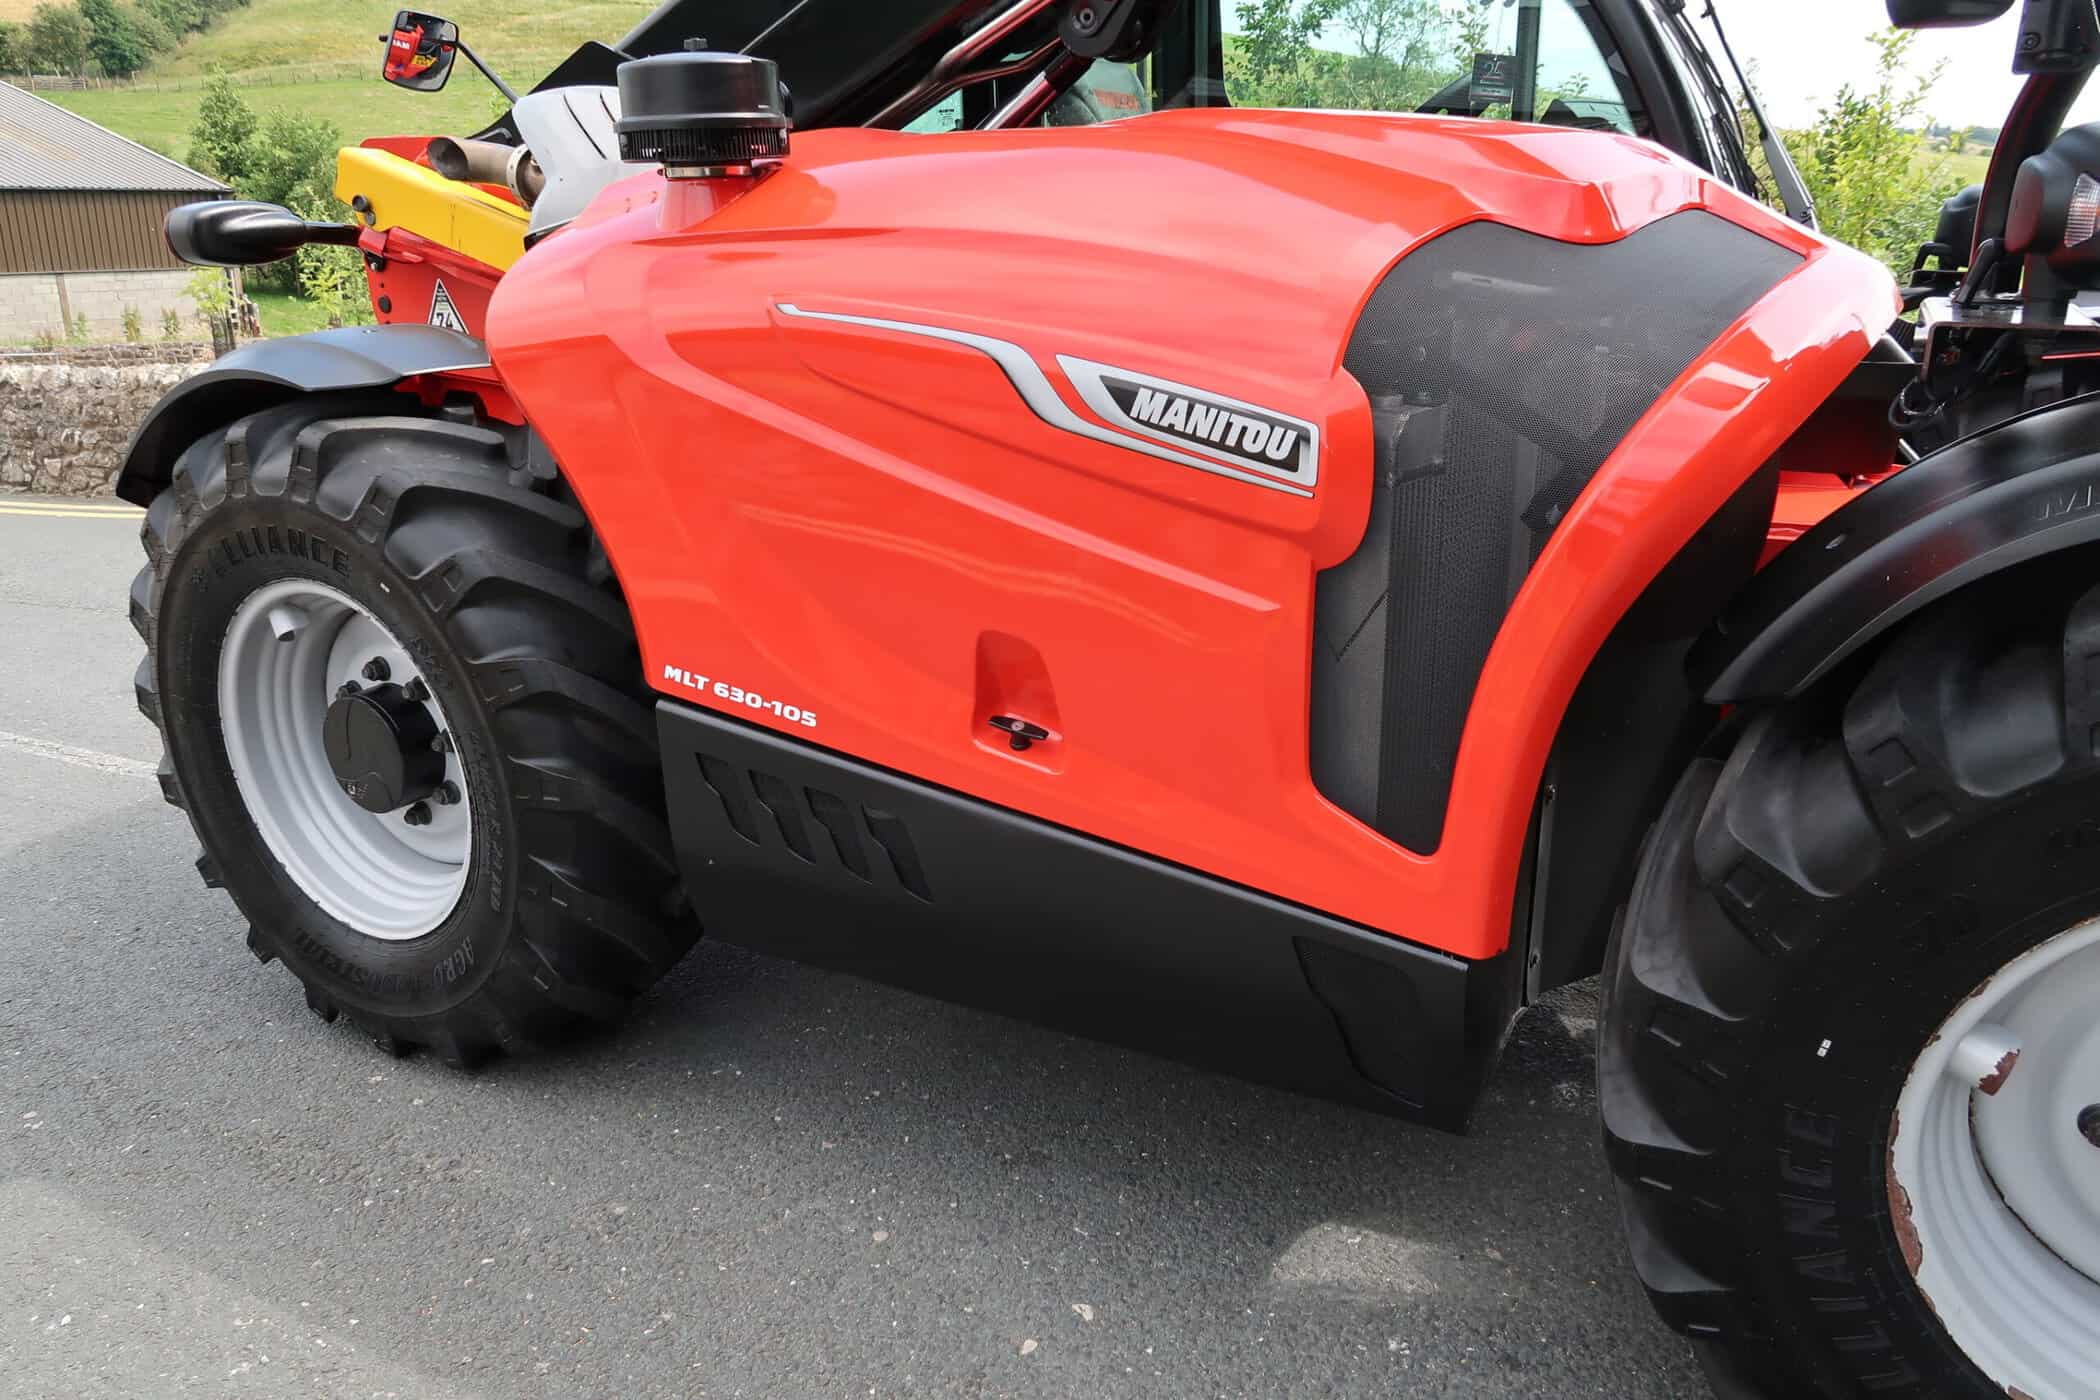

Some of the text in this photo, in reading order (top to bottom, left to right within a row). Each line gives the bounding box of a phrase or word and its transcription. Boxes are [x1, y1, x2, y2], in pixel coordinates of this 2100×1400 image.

[1129, 386, 1299, 461] MANITOU
[663, 664, 817, 727] MLT 630-105
